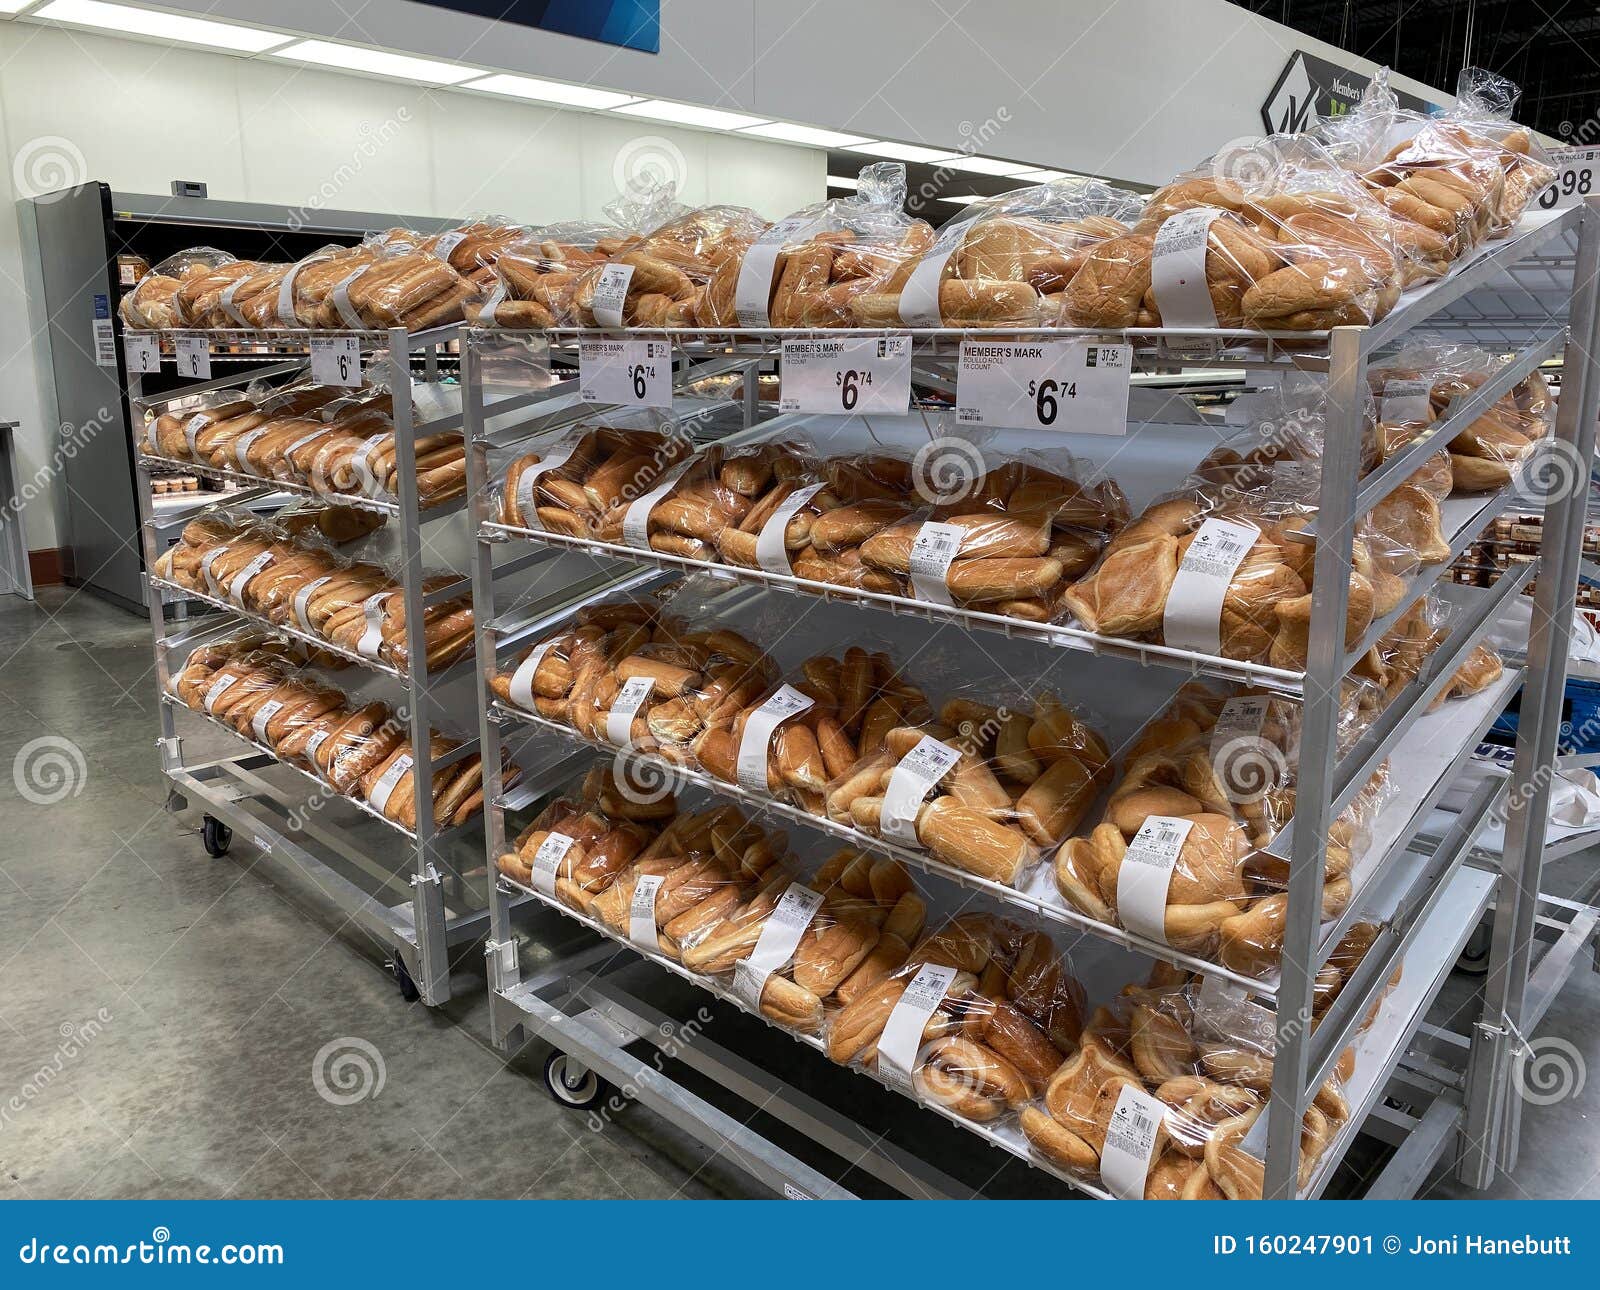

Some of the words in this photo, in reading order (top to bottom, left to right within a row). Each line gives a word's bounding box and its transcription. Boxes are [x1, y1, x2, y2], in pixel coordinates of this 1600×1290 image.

[1332, 78, 1360, 101] Member's
[784, 343, 821, 353] MEMBER'S
[823, 343, 844, 353] MARK
[963, 347, 1012, 358] MEMBER'S
[1013, 347, 1043, 359] MARK
[963, 356, 987, 364] BOLILLO
